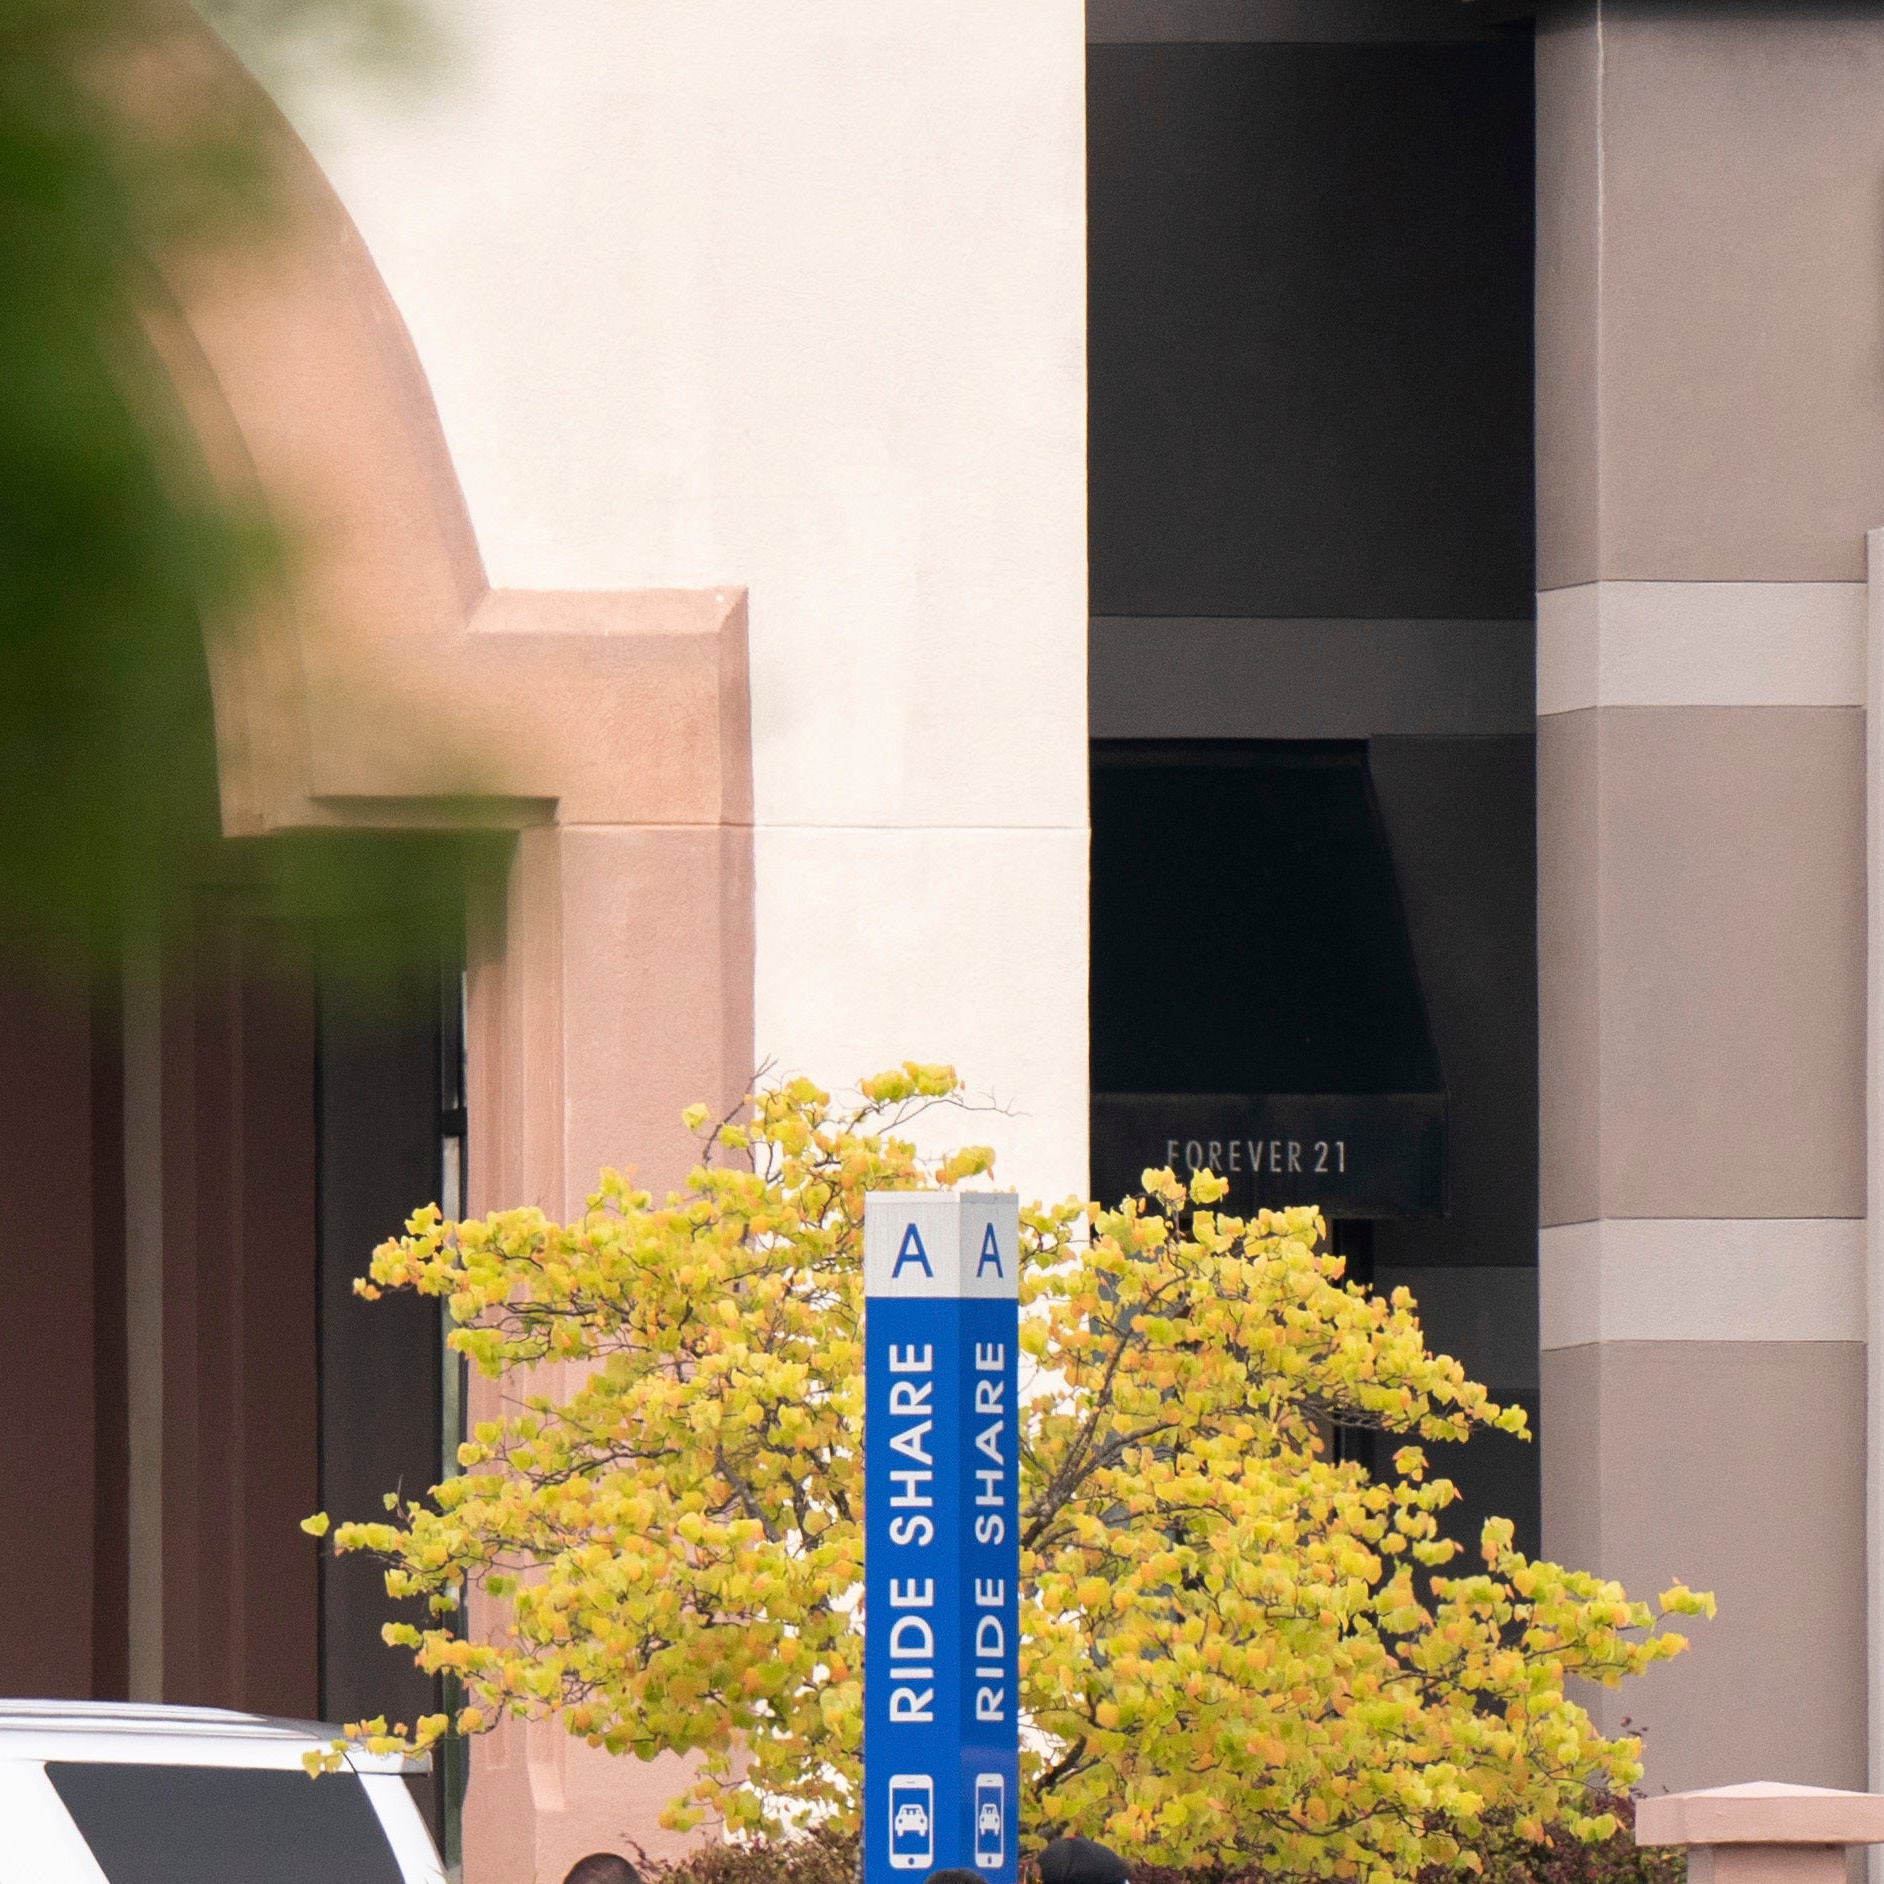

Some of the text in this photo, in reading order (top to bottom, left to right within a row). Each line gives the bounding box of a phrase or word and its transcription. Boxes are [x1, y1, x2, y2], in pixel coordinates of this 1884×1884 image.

[1167, 1139, 1346, 1173] FOREVER 21
[891, 1223, 934, 1278] A
[977, 1222, 1004, 1278] A
[889, 1343, 934, 1723] RIDE SHARE
[975, 1342, 1005, 1722] RIDE SHARE
